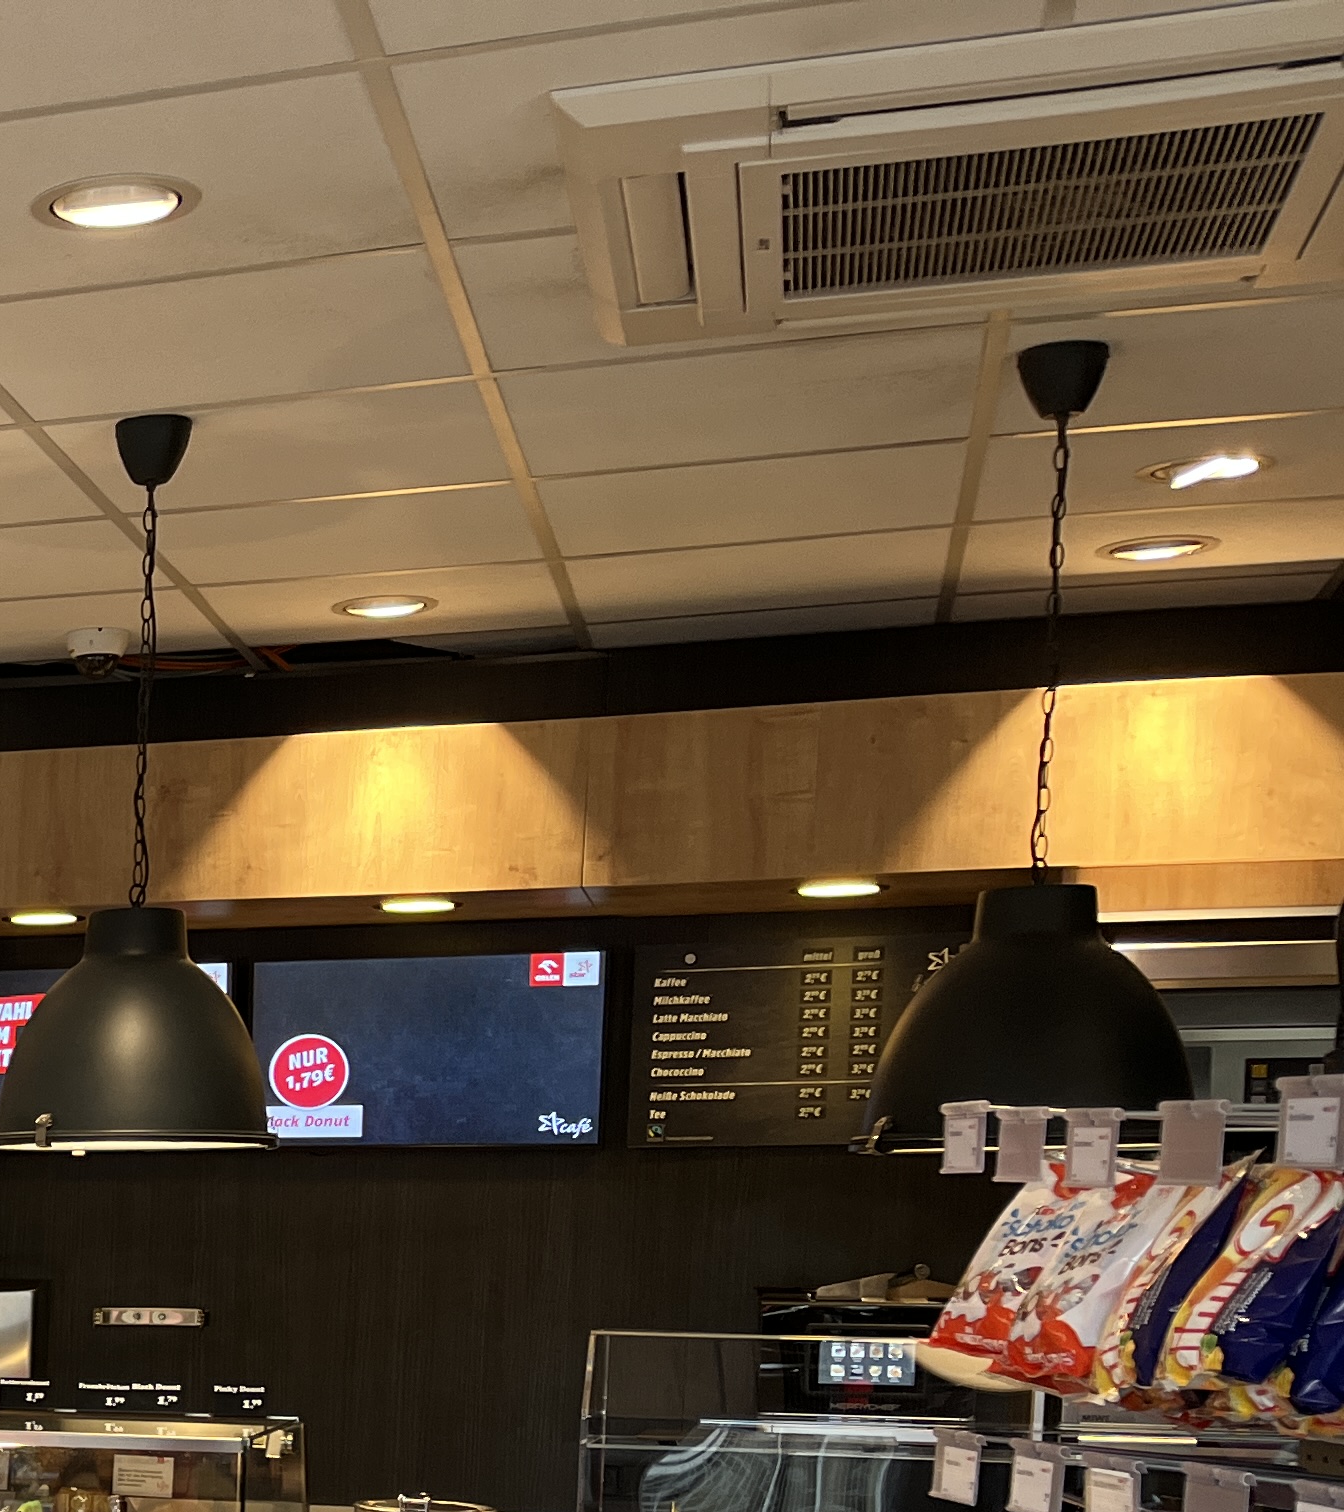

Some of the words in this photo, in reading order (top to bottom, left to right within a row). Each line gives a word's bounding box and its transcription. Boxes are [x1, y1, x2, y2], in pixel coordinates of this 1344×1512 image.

[654, 977, 687, 988] Kaffee
[653, 995, 711, 1006] Milchkaffee
[652, 1014, 678, 1024] Latte
[679, 1012, 729, 1023] Macchiato
[652, 1031, 708, 1042] Cappuccino
[288, 1047, 328, 1070] NUR
[651, 1050, 695, 1060] Espresso
[702, 1048, 752, 1058] Macchiato
[285, 1064, 335, 1091] 1,79€
[650, 1067, 705, 1078] Chococcino
[649, 1091, 678, 1101] Heiße
[679, 1090, 736, 1101] Schokolade
[649, 1109, 666, 1119] Tee
[304, 1114, 351, 1128] Donut
[558, 1114, 593, 1139] café
[998, 1235, 1050, 1258] Bons
[131, 1382, 155, 1391] Black
[155, 1383, 181, 1391] Donut
[214, 1385, 237, 1394] Pinky
[238, 1385, 266, 1393] Donut
